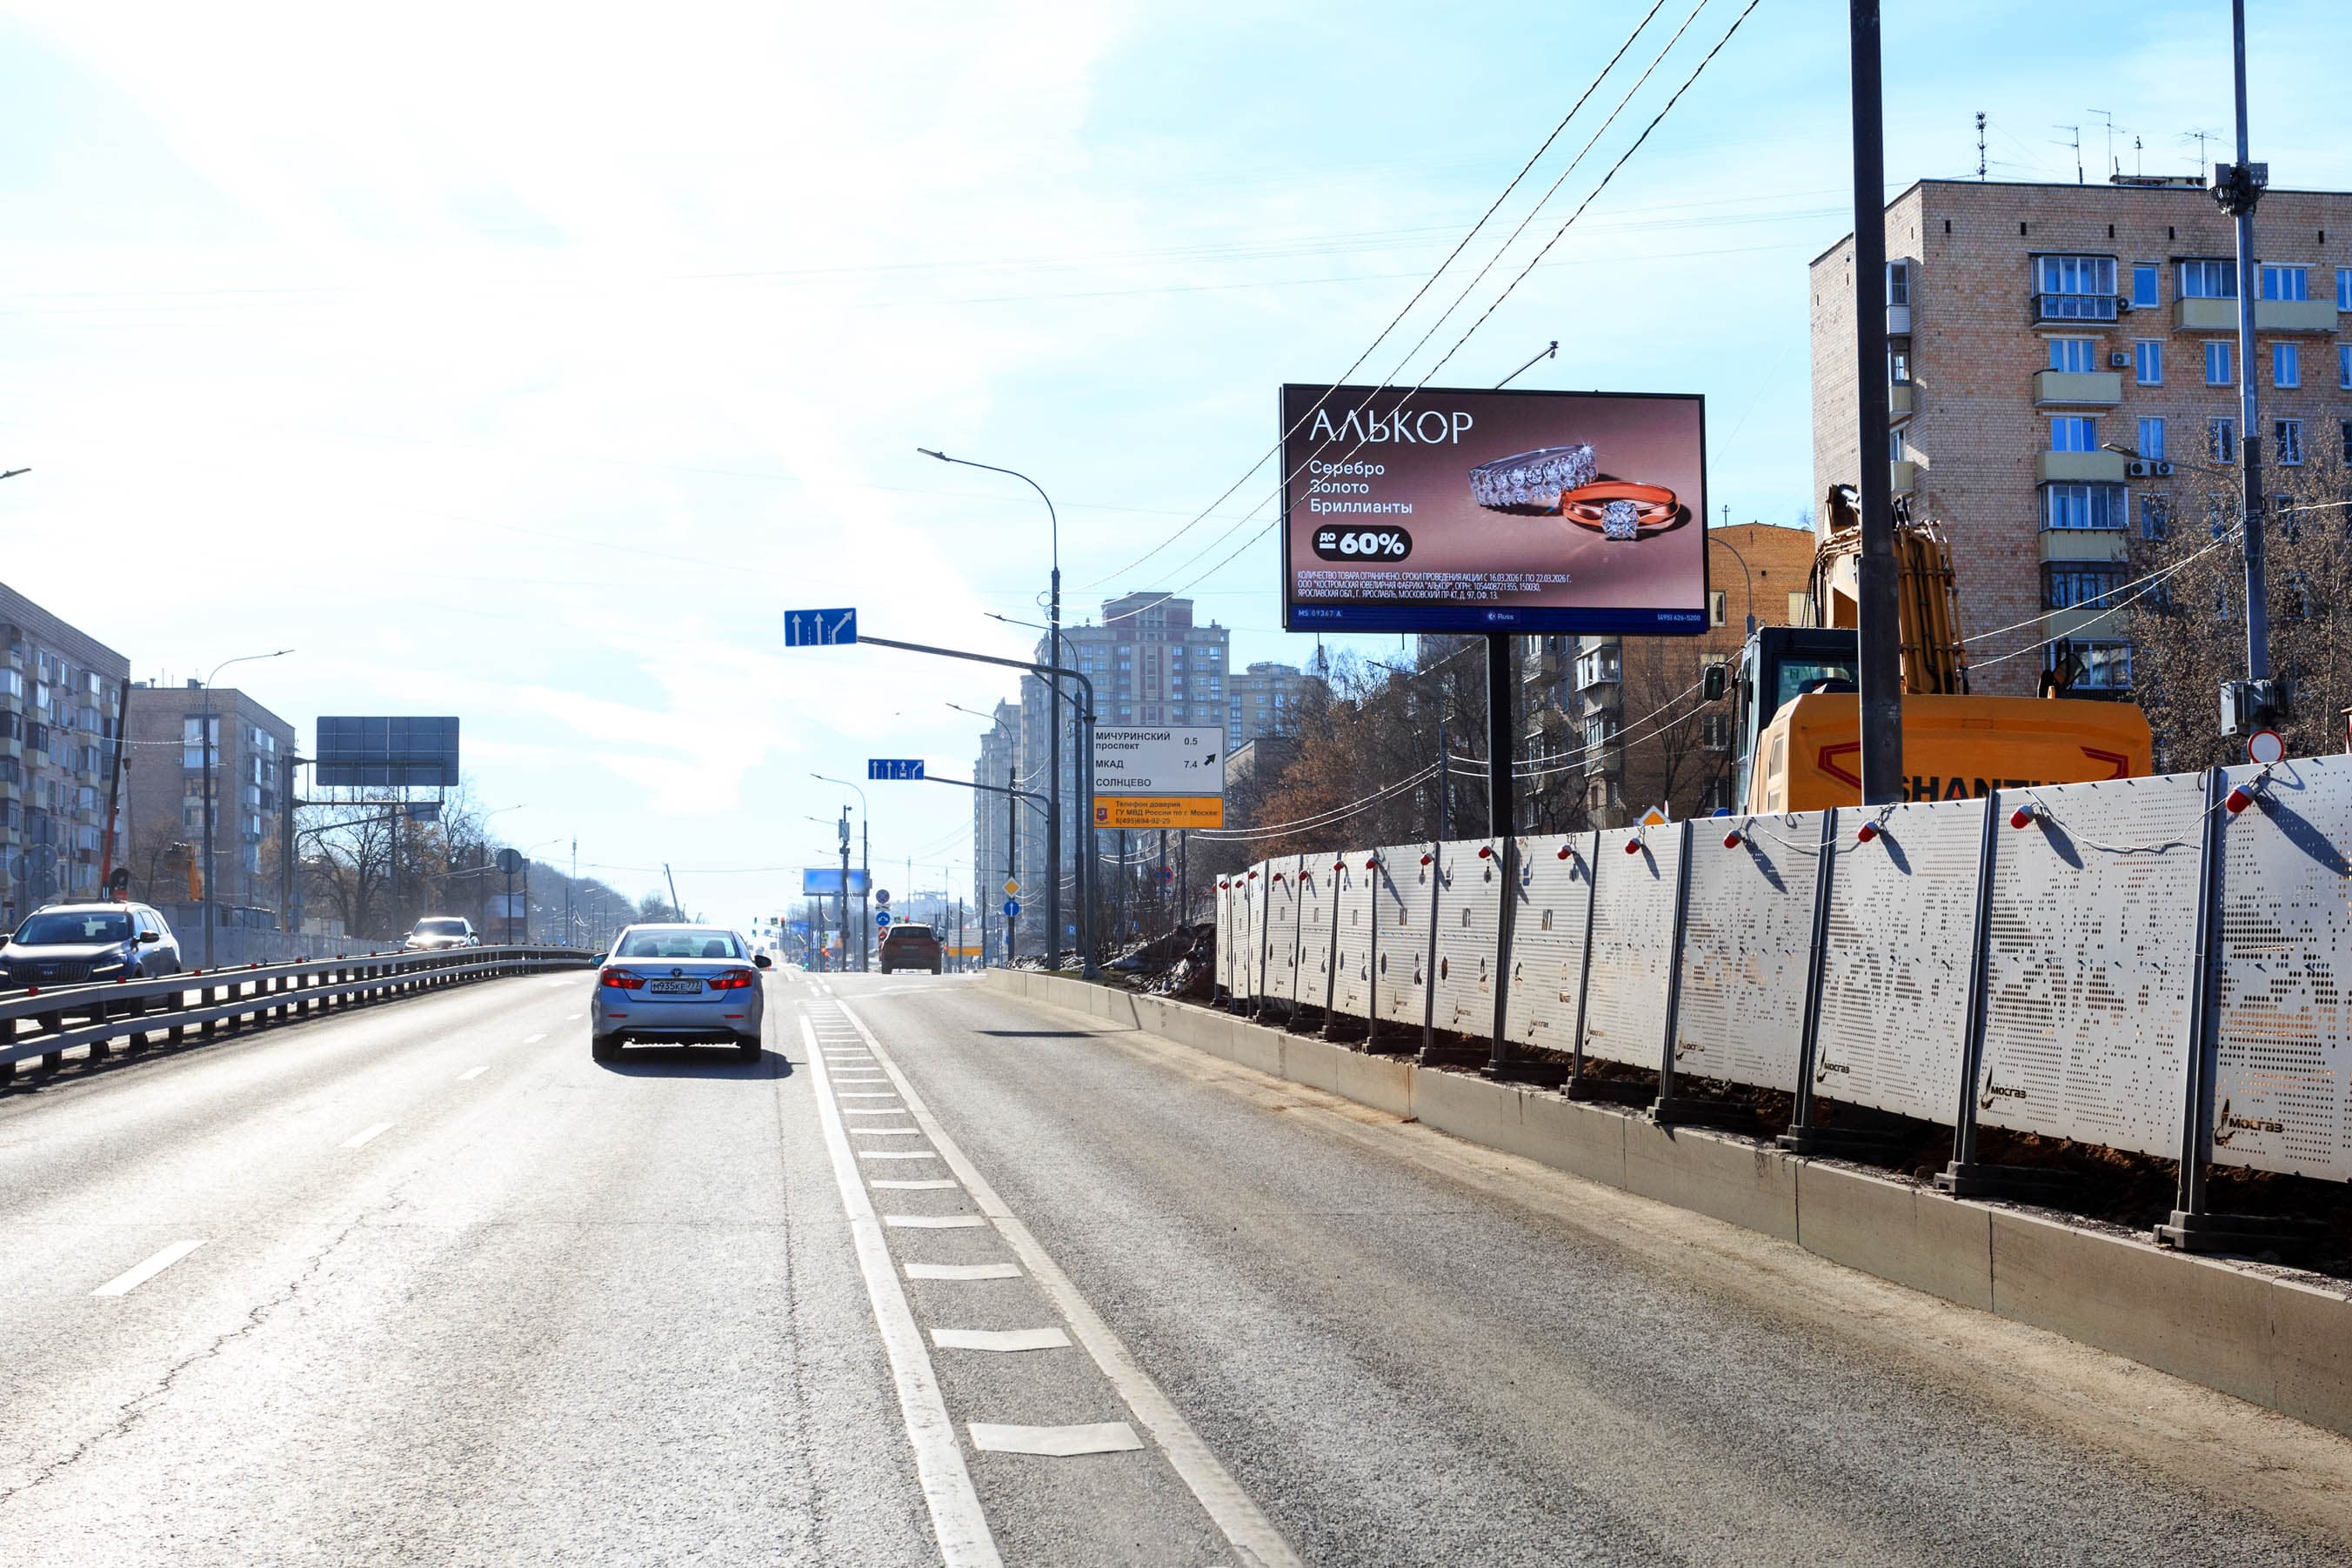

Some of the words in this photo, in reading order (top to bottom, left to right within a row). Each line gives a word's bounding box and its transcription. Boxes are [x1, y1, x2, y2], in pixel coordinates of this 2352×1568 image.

[1309, 409, 1473, 444] АЛЬКОР
[1309, 460, 1385, 477] Серебро
[1310, 479, 1369, 494] Золото
[1310, 498, 1413, 515] Бриллианты
[1320, 532, 1336, 542] до
[1298, 570, 1337, 579] КОЛИЧЕСТВО
[1338, 571, 1360, 580] ТОВАРА
[1360, 571, 1401, 581] ОГРАНИЧЕНО.
[1402, 572, 1421, 581] СРОКИ
[1423, 572, 1461, 582] ПРОВЕДЕНИЯ
[1462, 573, 1483, 582] АКЦИИ
[1490, 573, 1519, 582] 16.03.2026
[1535, 574, 1566, 583] 22.03.2026
[1298, 589, 1338, 597] ЯРОСЛАВСКАЯ
[1362, 590, 1397, 598] ЯРОСЛАВЛЬ,
[1095, 731, 1171, 741] МИЧУРИНСКИЙ
[1095, 760, 1124, 769] МКАД
[1184, 760, 1198, 769] 7.4
[1095, 778, 1152, 788] СОЛНЦЕВО
